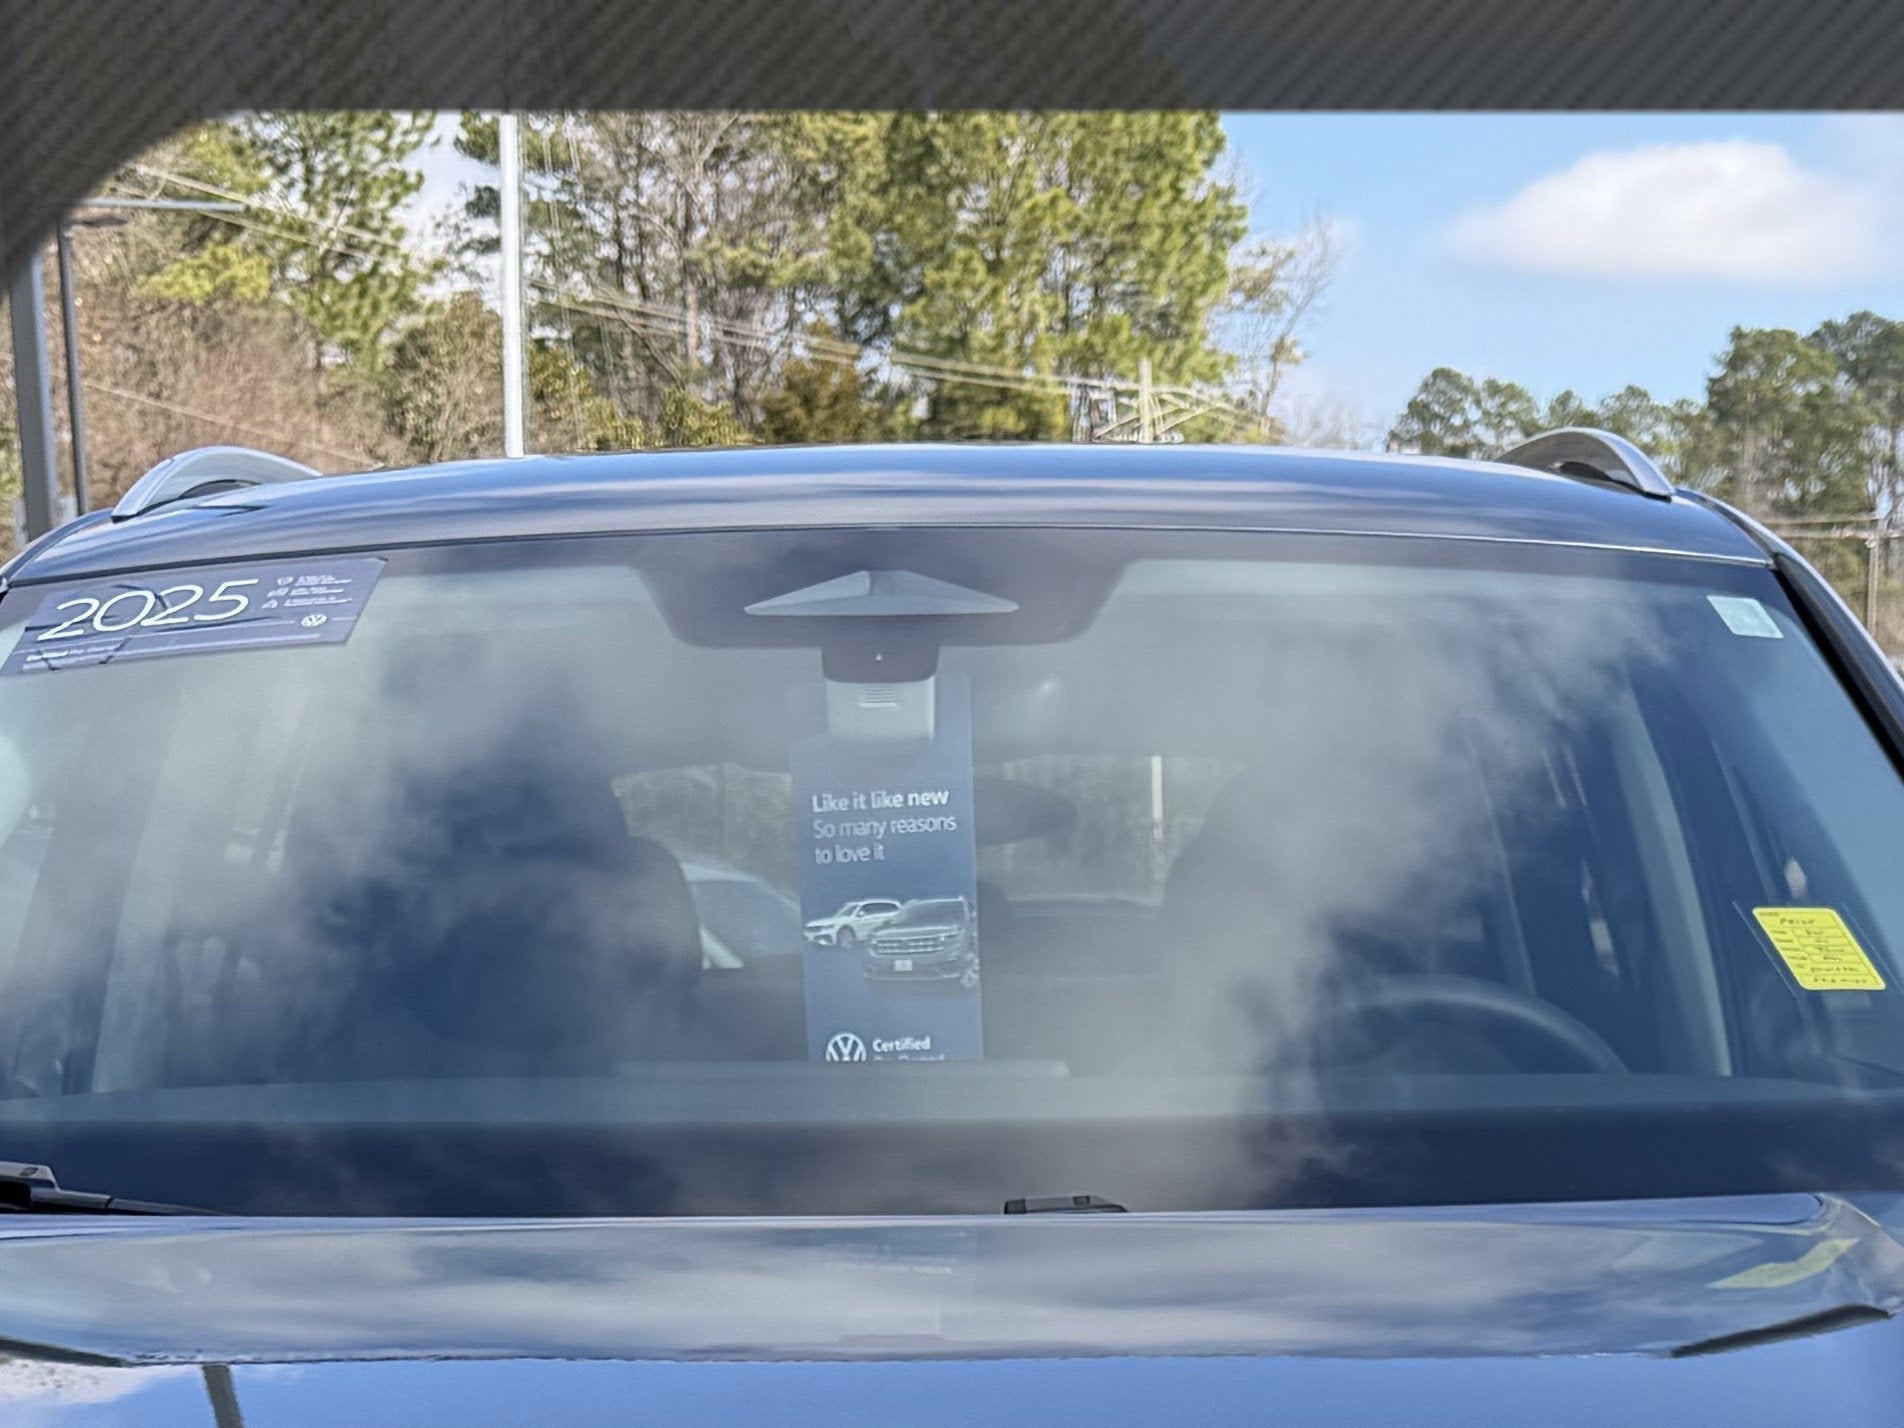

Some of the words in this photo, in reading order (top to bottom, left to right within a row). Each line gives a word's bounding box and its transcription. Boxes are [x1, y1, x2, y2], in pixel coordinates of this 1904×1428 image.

[37, 578, 259, 642] 2025
[812, 792, 849, 812] Like
[852, 790, 867, 810] it
[870, 790, 904, 809] like
[907, 790, 949, 807] new
[812, 819, 836, 839] So
[838, 820, 887, 840] many
[890, 815, 957, 834] reasons
[814, 847, 833, 864] to
[835, 844, 871, 862] love
[873, 842, 886, 861] it
[872, 1035, 932, 1053] Certified
